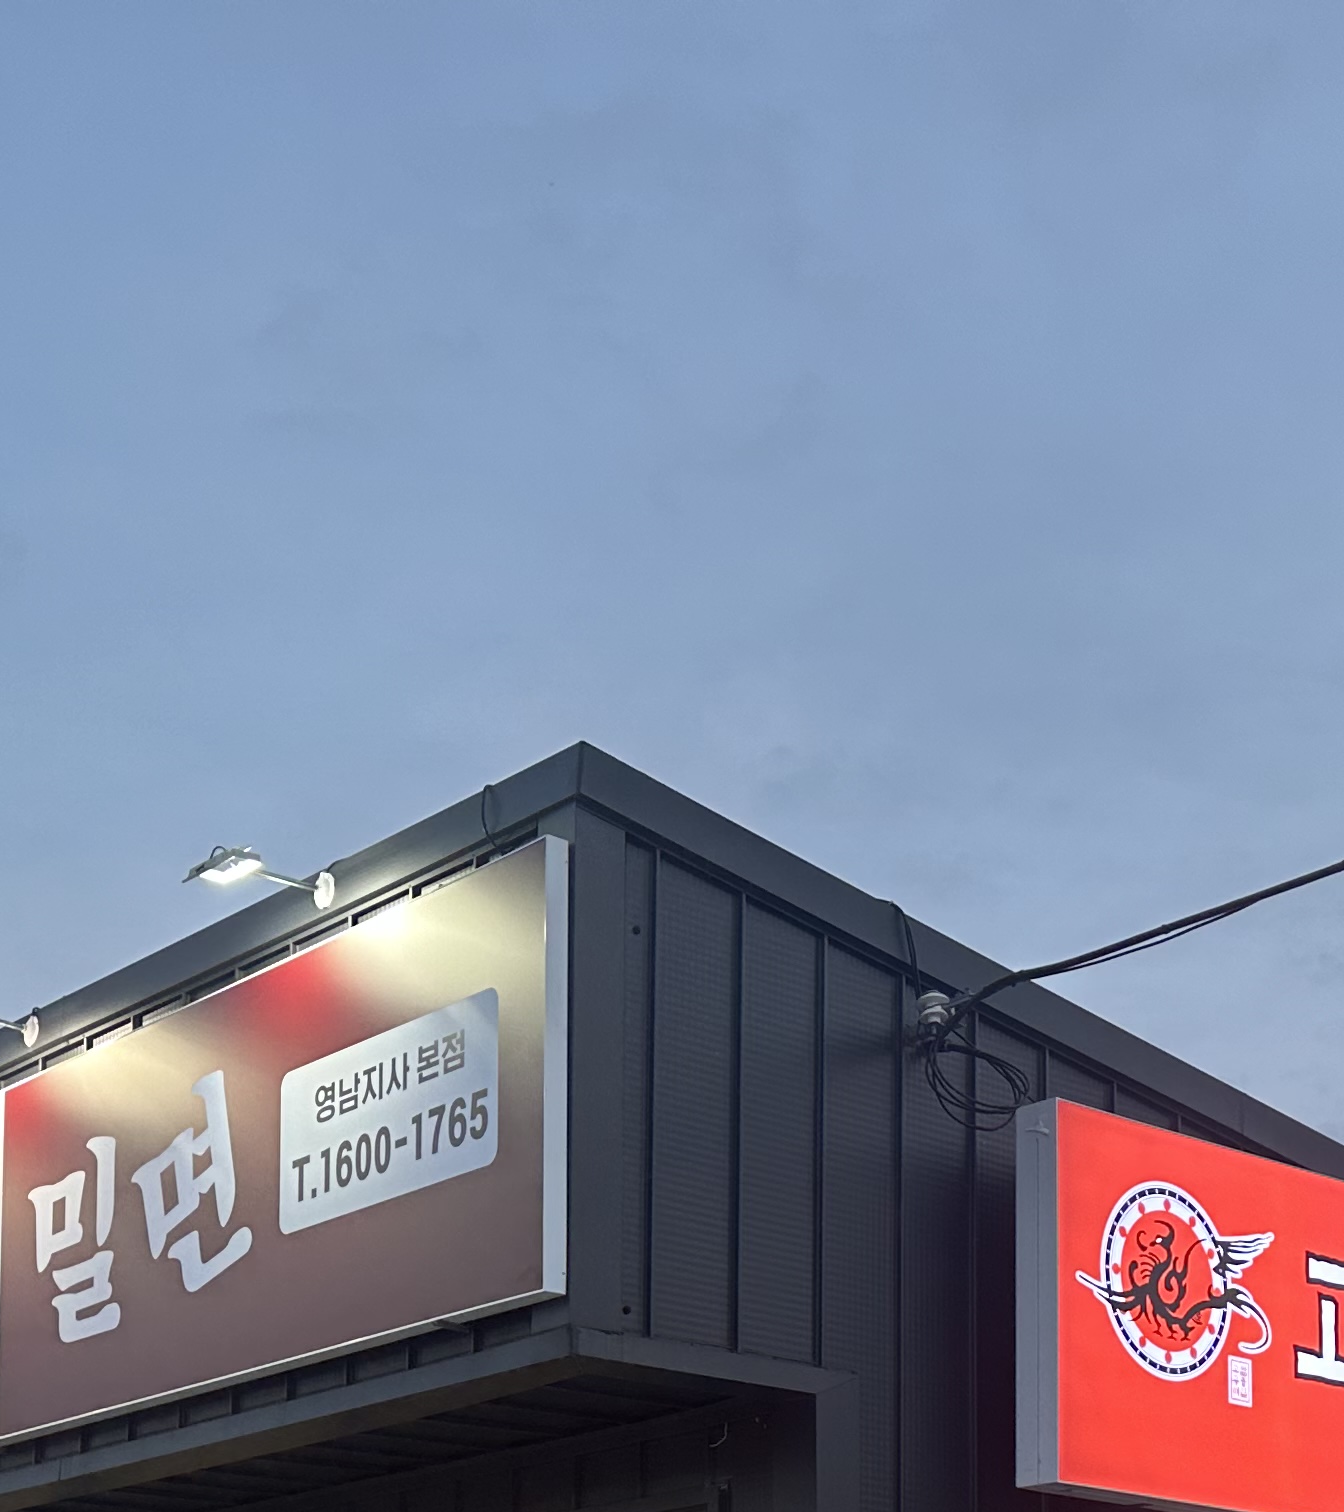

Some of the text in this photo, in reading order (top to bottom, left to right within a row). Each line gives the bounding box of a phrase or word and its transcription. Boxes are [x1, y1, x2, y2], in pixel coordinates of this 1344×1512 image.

[314, 1029, 465, 1123] 영남지사 본점
[291, 1088, 489, 1203] T.1600-1765
